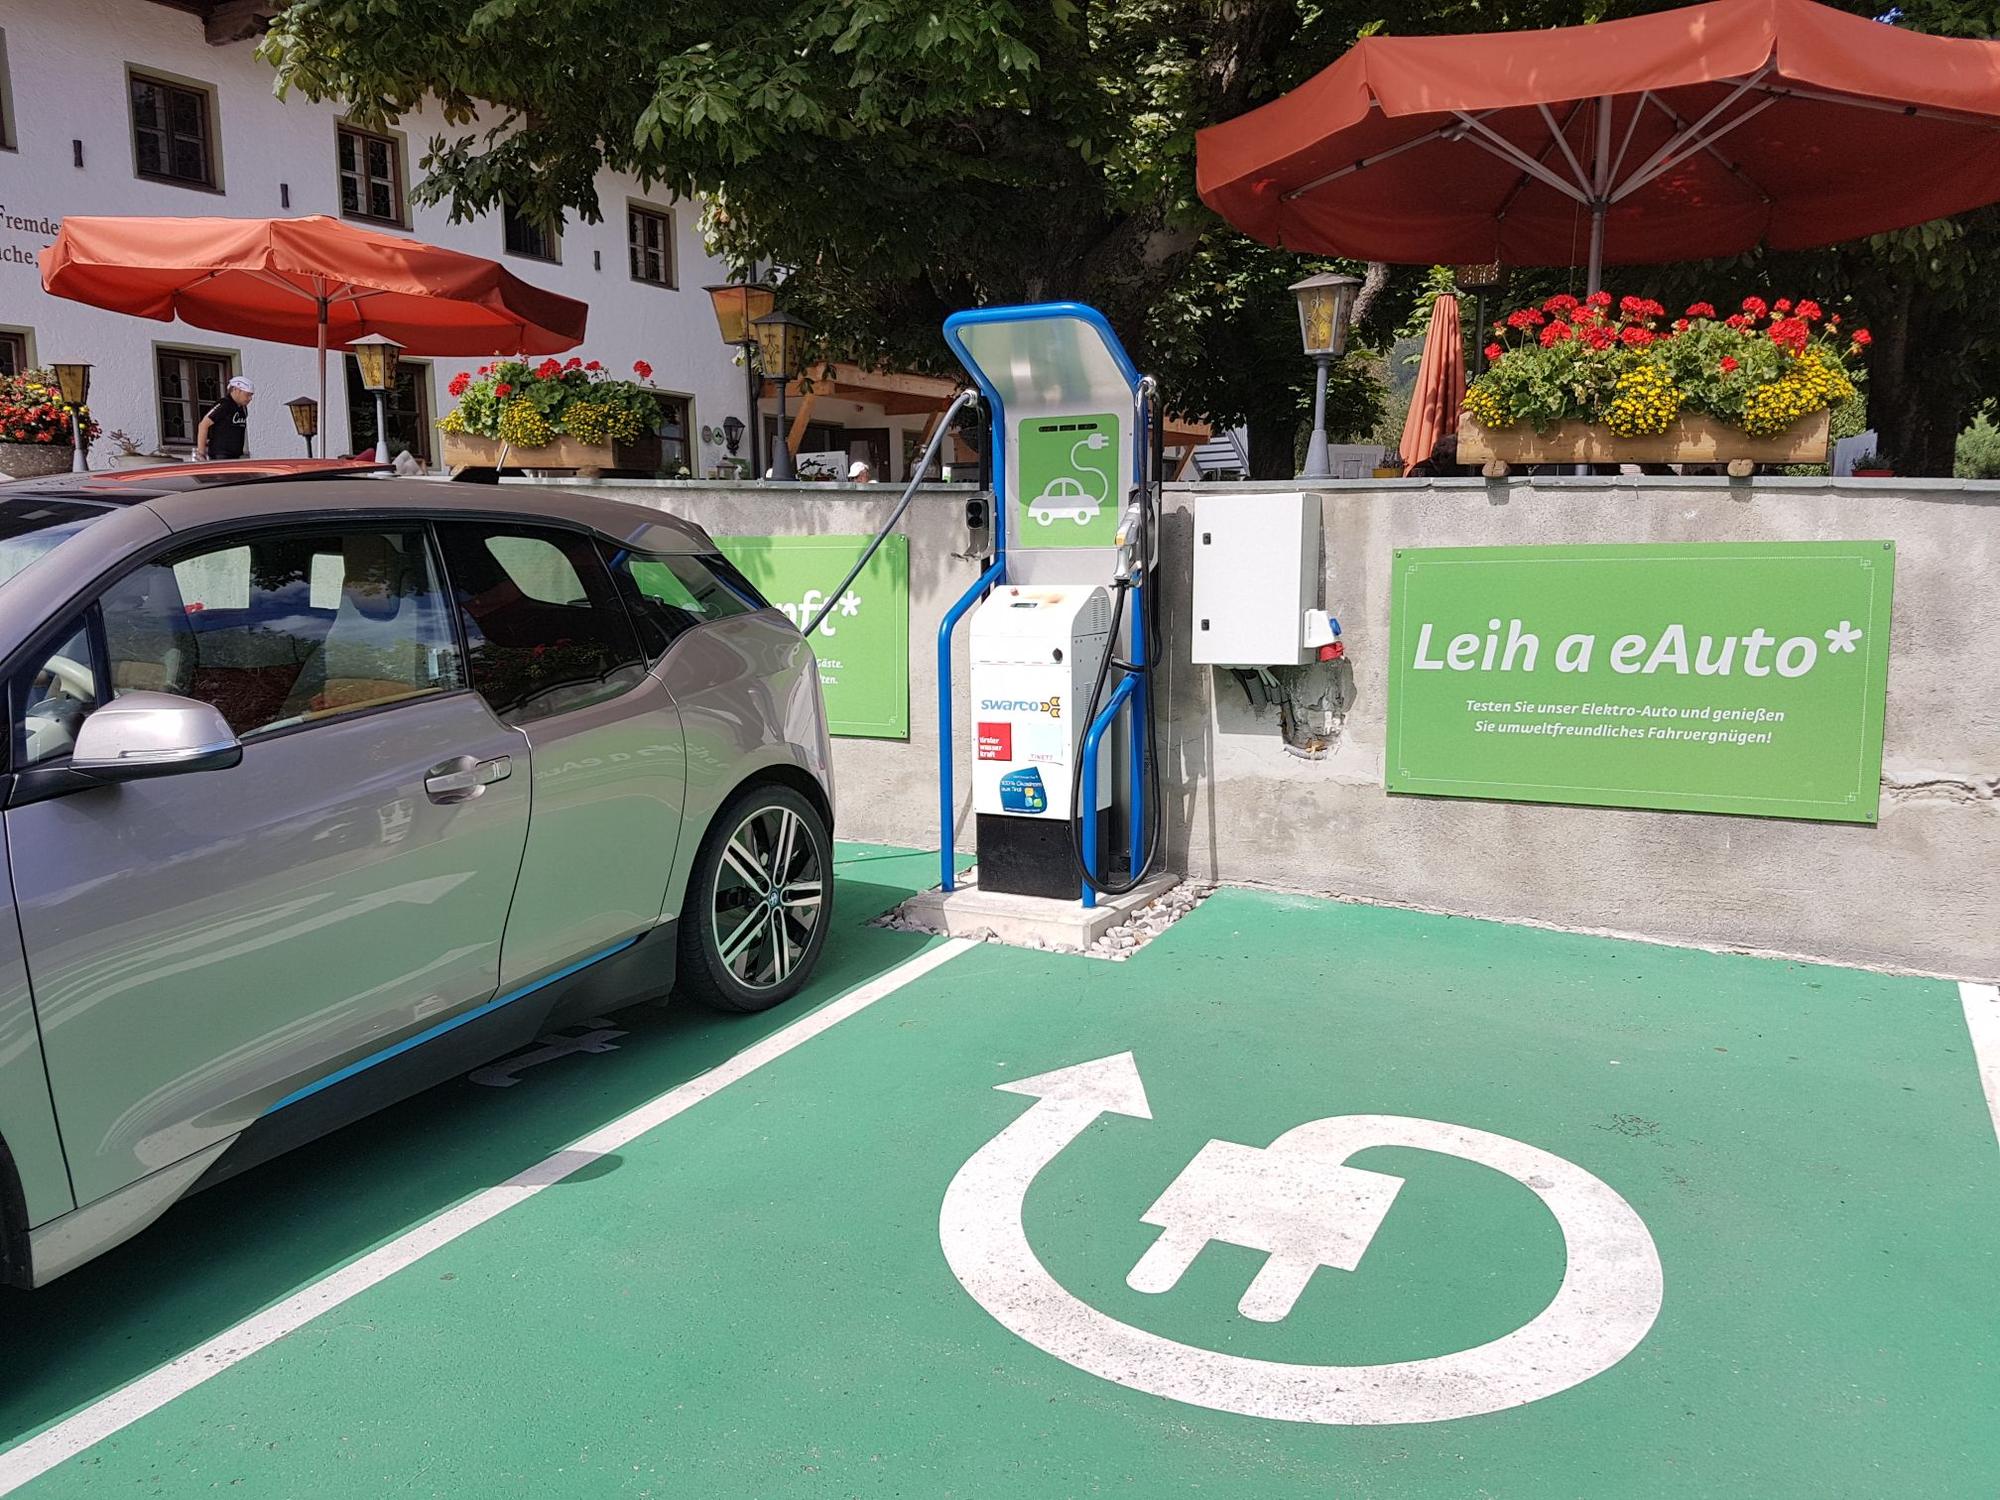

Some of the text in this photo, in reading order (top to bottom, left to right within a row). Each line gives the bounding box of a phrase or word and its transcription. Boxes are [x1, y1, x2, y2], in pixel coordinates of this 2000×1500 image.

[1413, 618, 1541, 672] Leih
[1554, 633, 1595, 673] a
[981, 699, 1039, 712] swarco
[1466, 700, 1785, 724] Testen Sie unser Elektro-Auto und genießen
[1474, 720, 1773, 746] Sie umweltfreundliches Fahrvergnügen!
